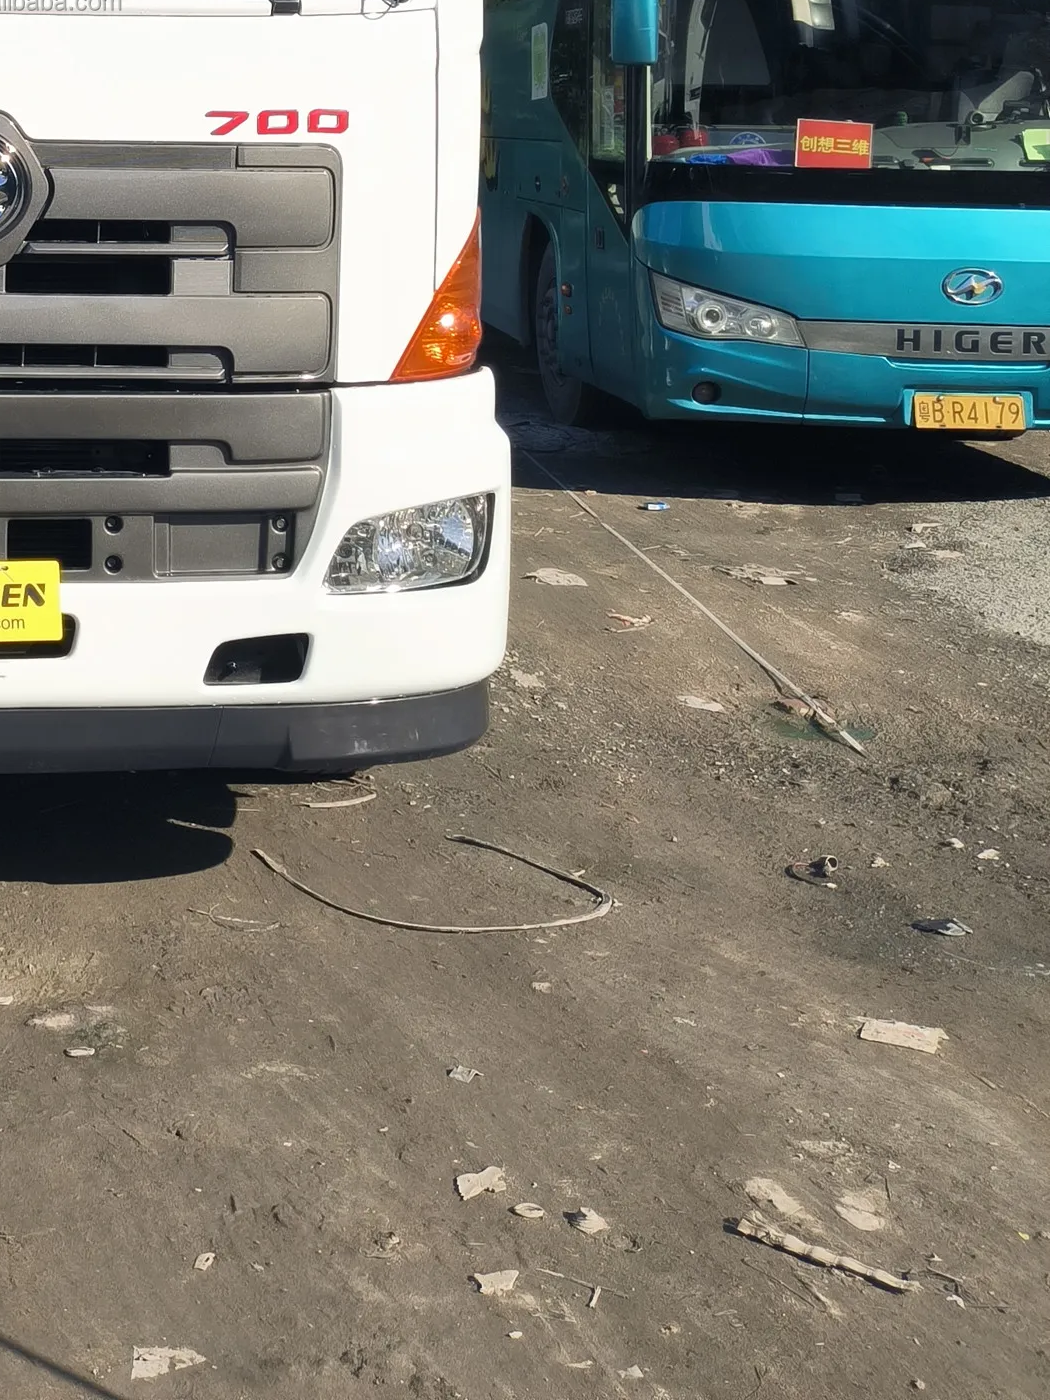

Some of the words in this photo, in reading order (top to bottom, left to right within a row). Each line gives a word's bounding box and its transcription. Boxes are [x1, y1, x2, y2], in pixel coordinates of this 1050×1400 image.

[204, 108, 350, 136] 700
[800, 135, 870, 156] 创想三维
[896, 328, 1047, 355] HIGER
